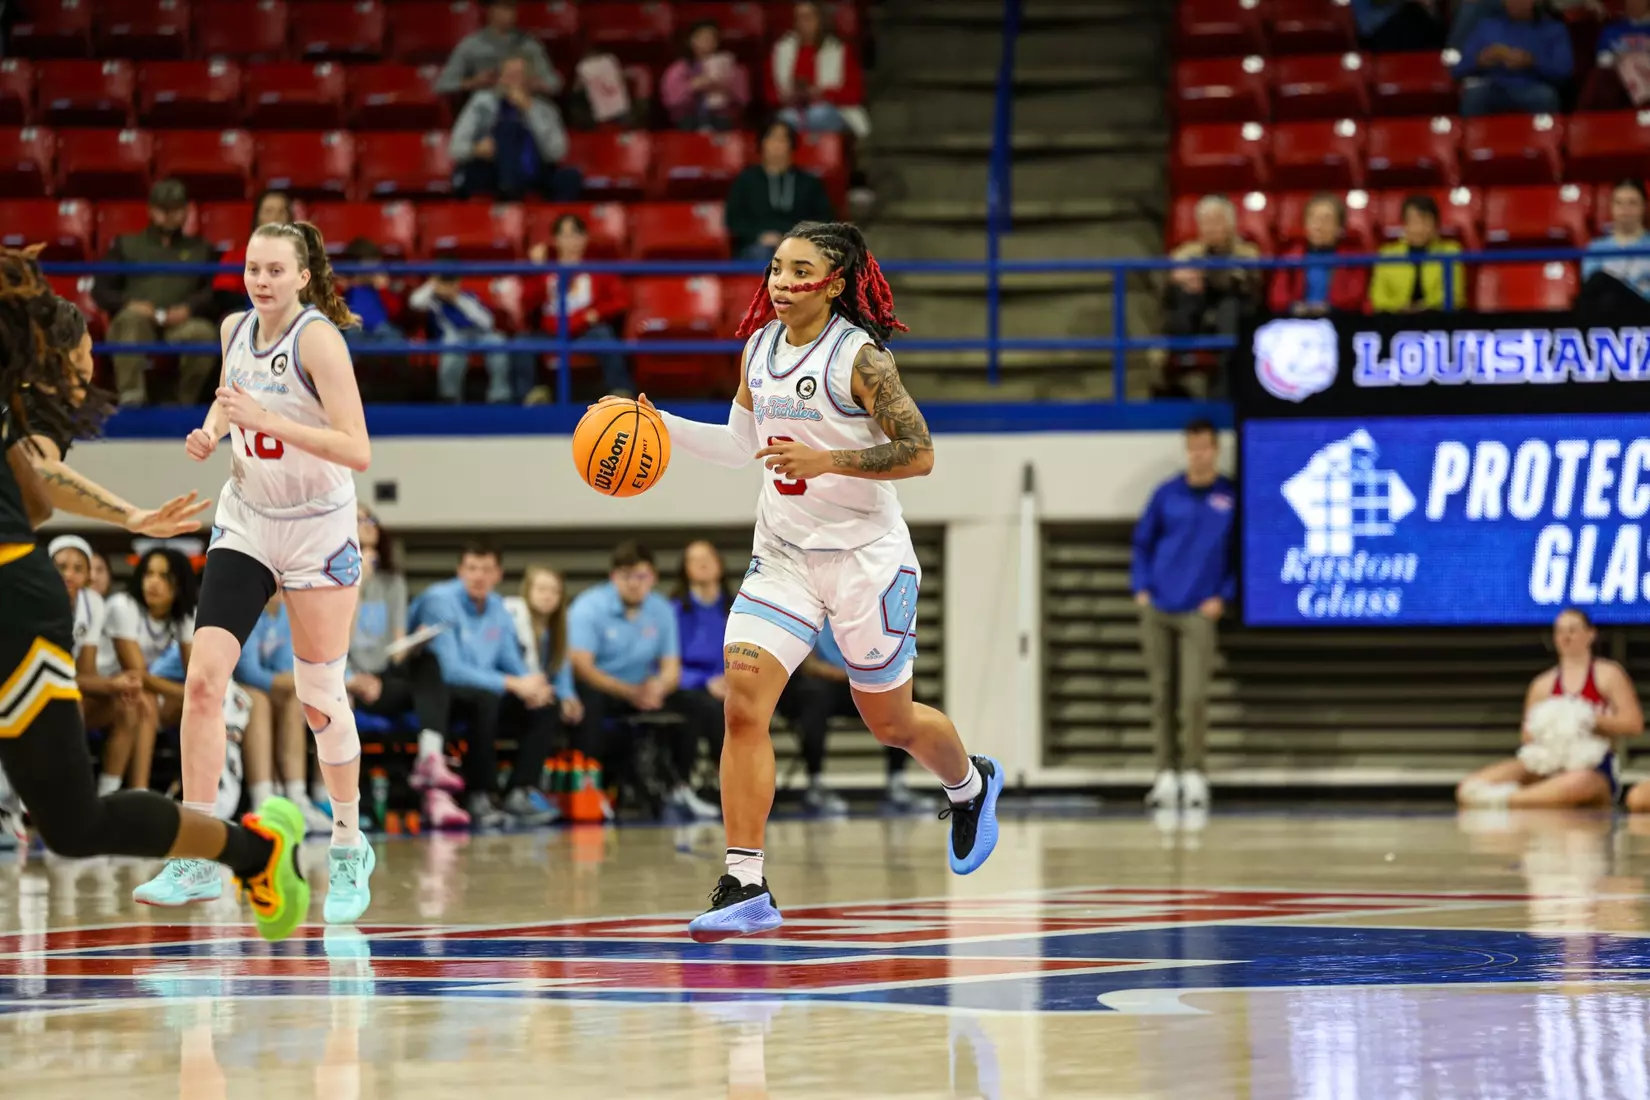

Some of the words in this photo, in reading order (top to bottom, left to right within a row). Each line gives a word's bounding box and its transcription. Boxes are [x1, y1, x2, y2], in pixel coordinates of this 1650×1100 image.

[594, 431, 630, 490] Wilson
[1425, 437, 1650, 521] PROTEC
[1528, 523, 1650, 605] GLA
